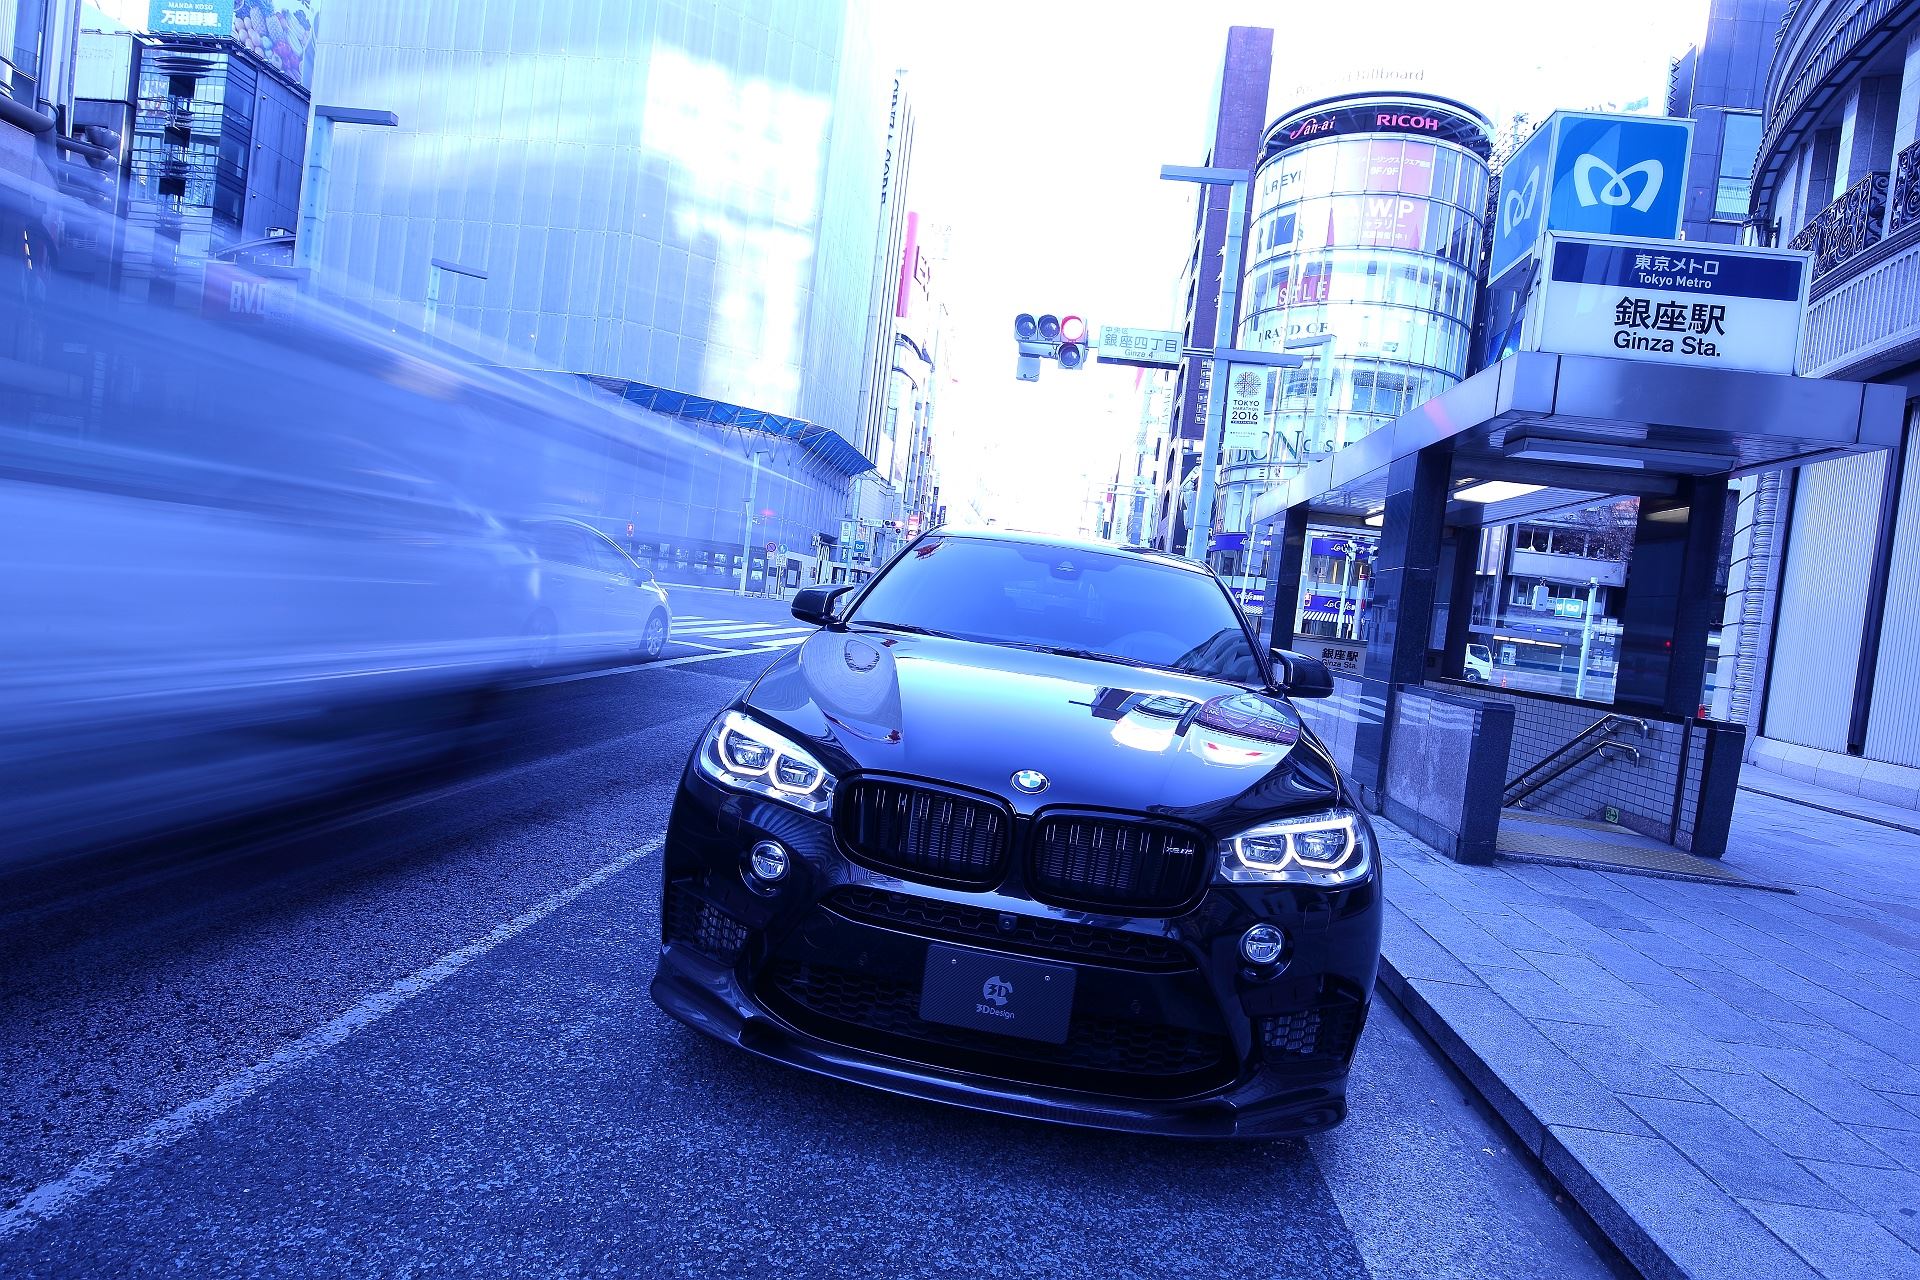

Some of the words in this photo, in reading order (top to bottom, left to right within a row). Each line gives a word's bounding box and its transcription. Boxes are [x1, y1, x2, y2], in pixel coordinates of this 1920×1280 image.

[168, 1, 193, 9] MANDA
[194, 3, 213, 11] KOSO
[1376, 114, 1440, 131] RICOH
[1634, 253, 1720, 276] 東京メトロ
[1638, 271, 1673, 288] Tokyo
[1676, 273, 1712, 290] Metro
[1613, 295, 1726, 337] 銀座駅
[1103, 333, 1178, 353] 銀座四丁目
[1613, 329, 1675, 354] Ginza
[1680, 335, 1722, 358] Sta.
[1124, 348, 1146, 358] Ginza
[1233, 399, 1260, 407] TOKYO
[1231, 411, 1259, 421] 2016
[1321, 647, 1359, 663] 銀座駅
[1321, 658, 1342, 667] Ginza
